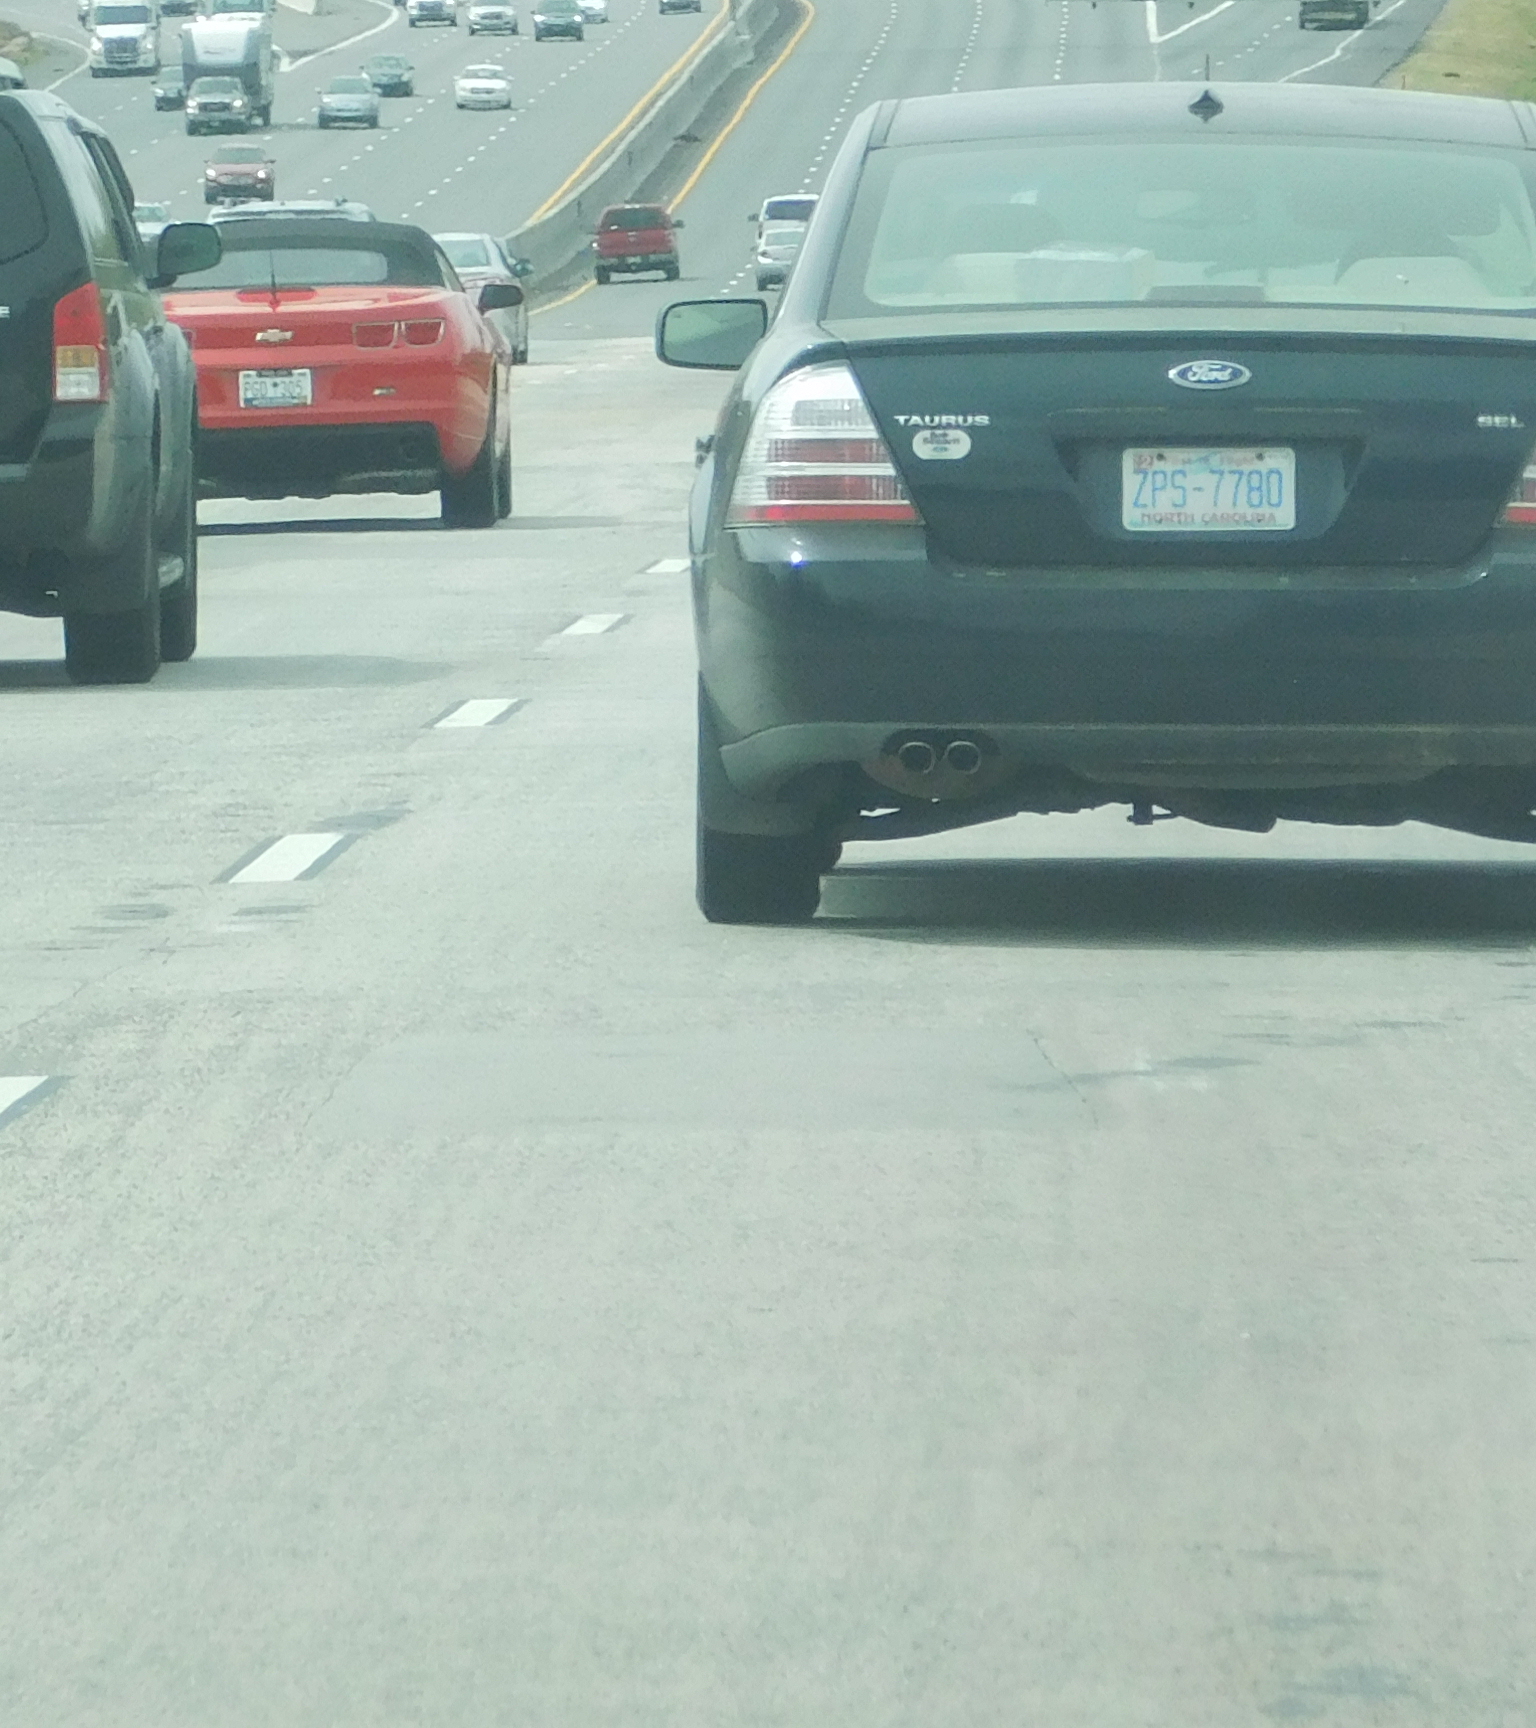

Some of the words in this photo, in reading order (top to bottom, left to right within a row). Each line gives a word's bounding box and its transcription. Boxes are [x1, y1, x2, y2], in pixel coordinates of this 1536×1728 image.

[1186, 363, 1233, 383] Ford
[893, 414, 991, 427] TAURUS
[1477, 415, 1526, 428] SEL
[1132, 467, 1284, 509] ZPS-7780
[1140, 512, 1195, 525] NORTH
[1200, 512, 1277, 525] CAROLINA
